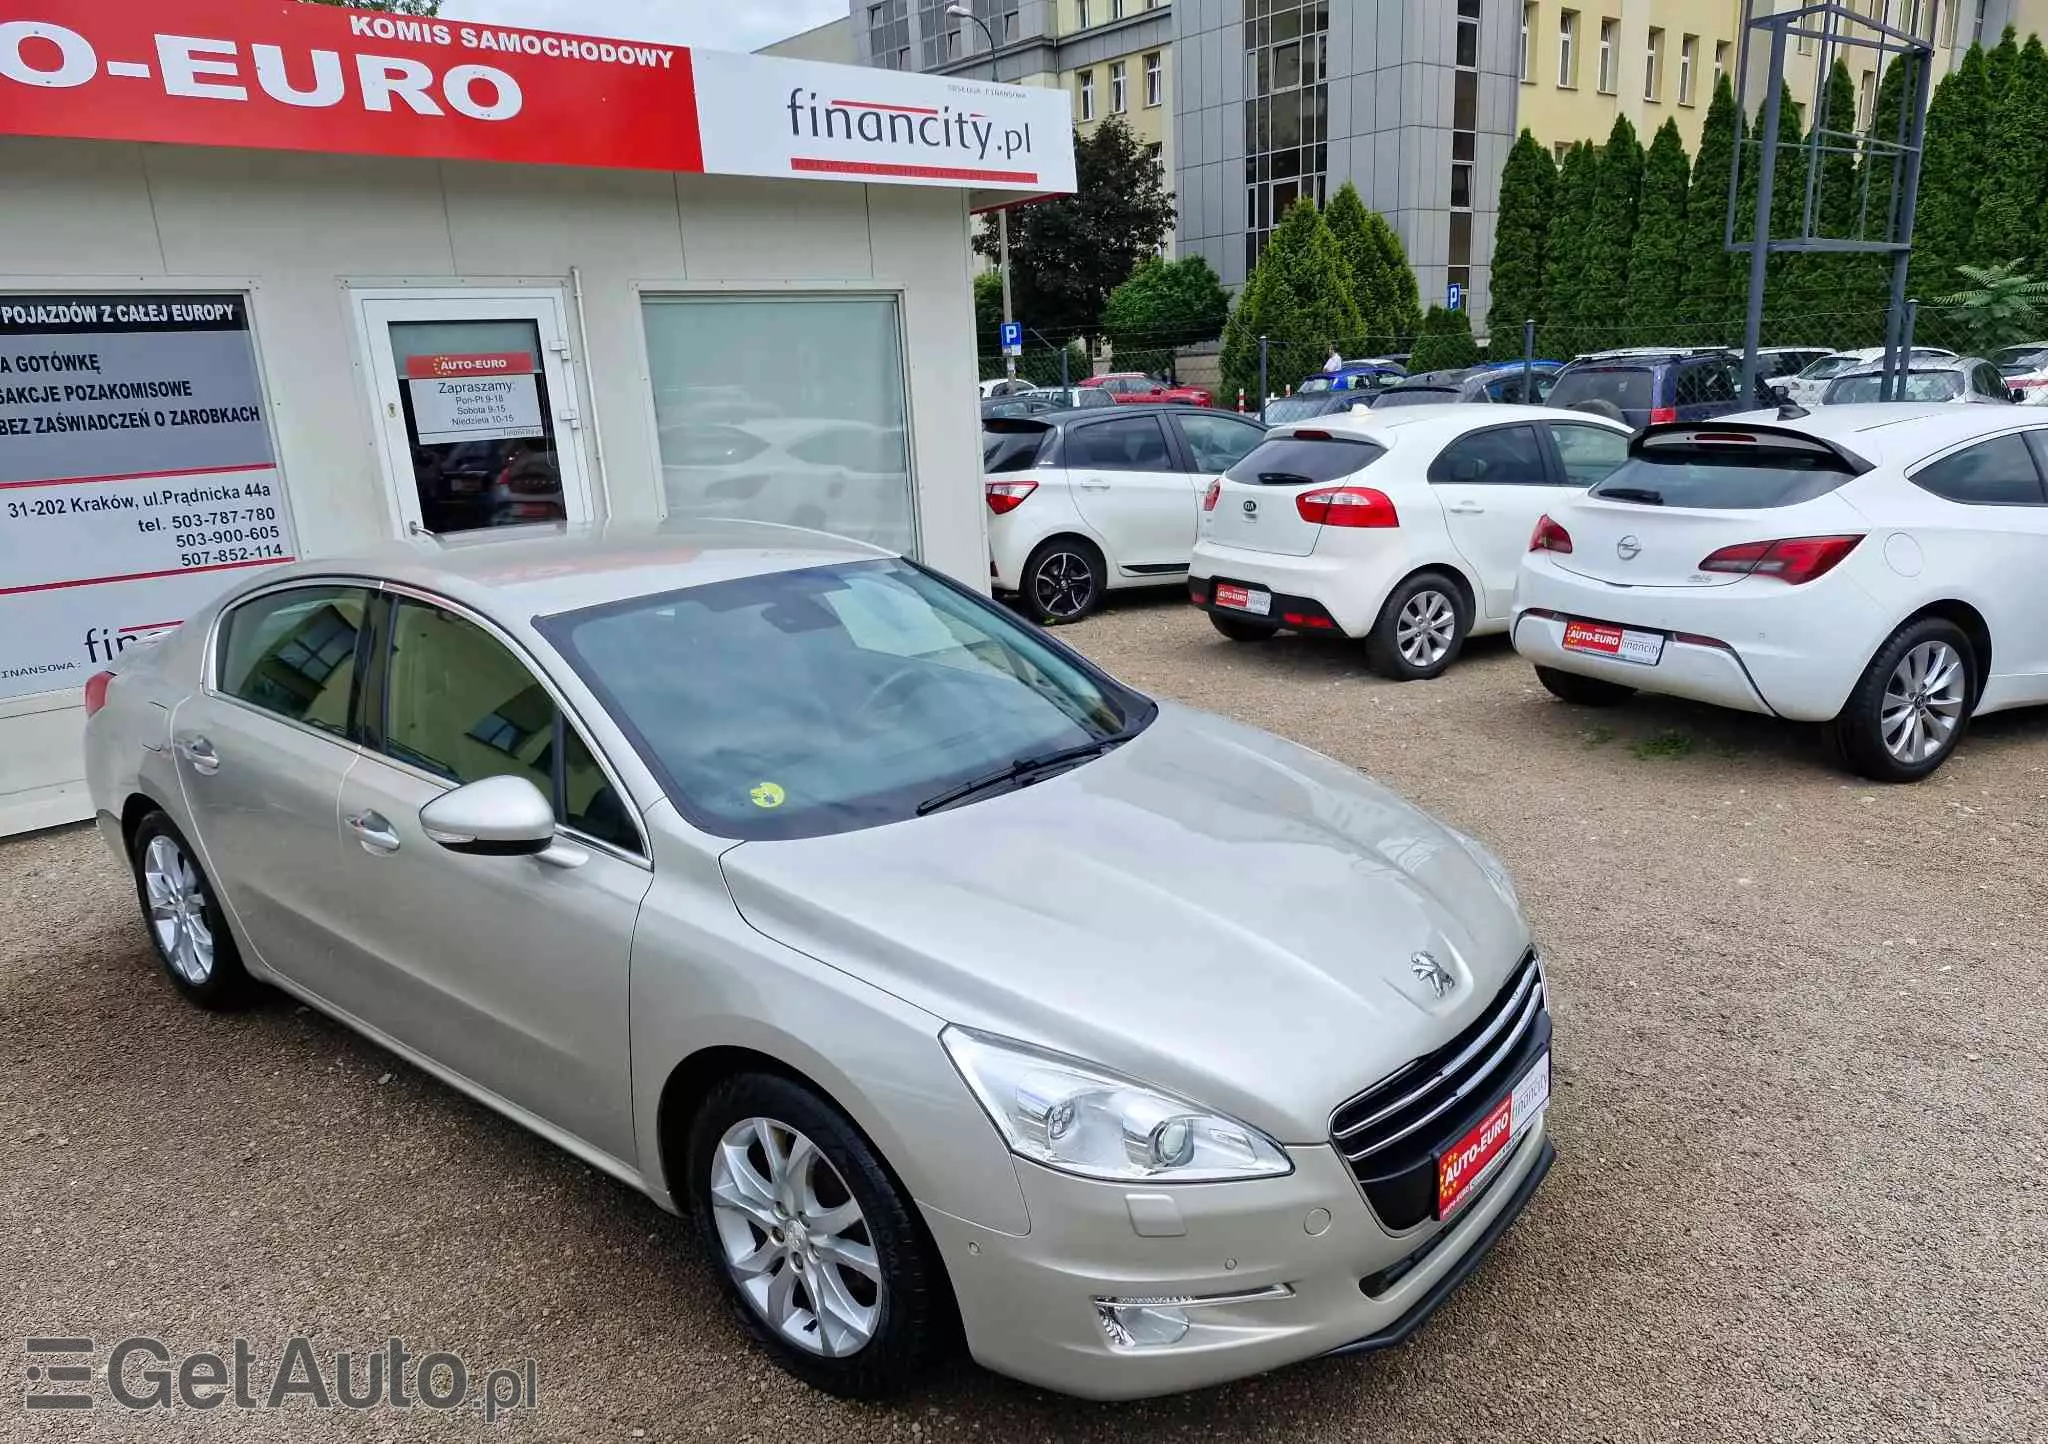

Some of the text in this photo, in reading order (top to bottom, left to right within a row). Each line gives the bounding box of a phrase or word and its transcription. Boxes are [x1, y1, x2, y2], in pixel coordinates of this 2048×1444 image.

[350, 14, 674, 69] KOMIS SAMOCHODOWY
[0, 20, 524, 122] O-EURO
[786, 87, 1032, 160] financity.pl
[1450, 287, 1458, 309] P
[1, 302, 234, 324] POJAZDÓW Z CAŁEJ EUROPY
[1006, 325, 1017, 344] P
[15, 351, 102, 375] GOTÓWKĘ
[440, 359, 507, 370] AUTO-EURO
[64, 380, 192, 402] POZAKOMISOWE
[0, 405, 261, 436] BEZ ZAŚWIADCZEŃ O ZAROBKACH
[457, 408, 486, 416] Sobota
[8, 482, 272, 519] 31-202 Kraków, ul.Prądnicka 44a
[138, 506, 276, 533] tel. 503-787-780
[176, 525, 280, 549] 503-900-605
[181, 542, 283, 568] 507-852-114
[1571, 630, 1620, 646] AUTO-EURO
[1446, 1112, 1509, 1186] AUTO-EURO
